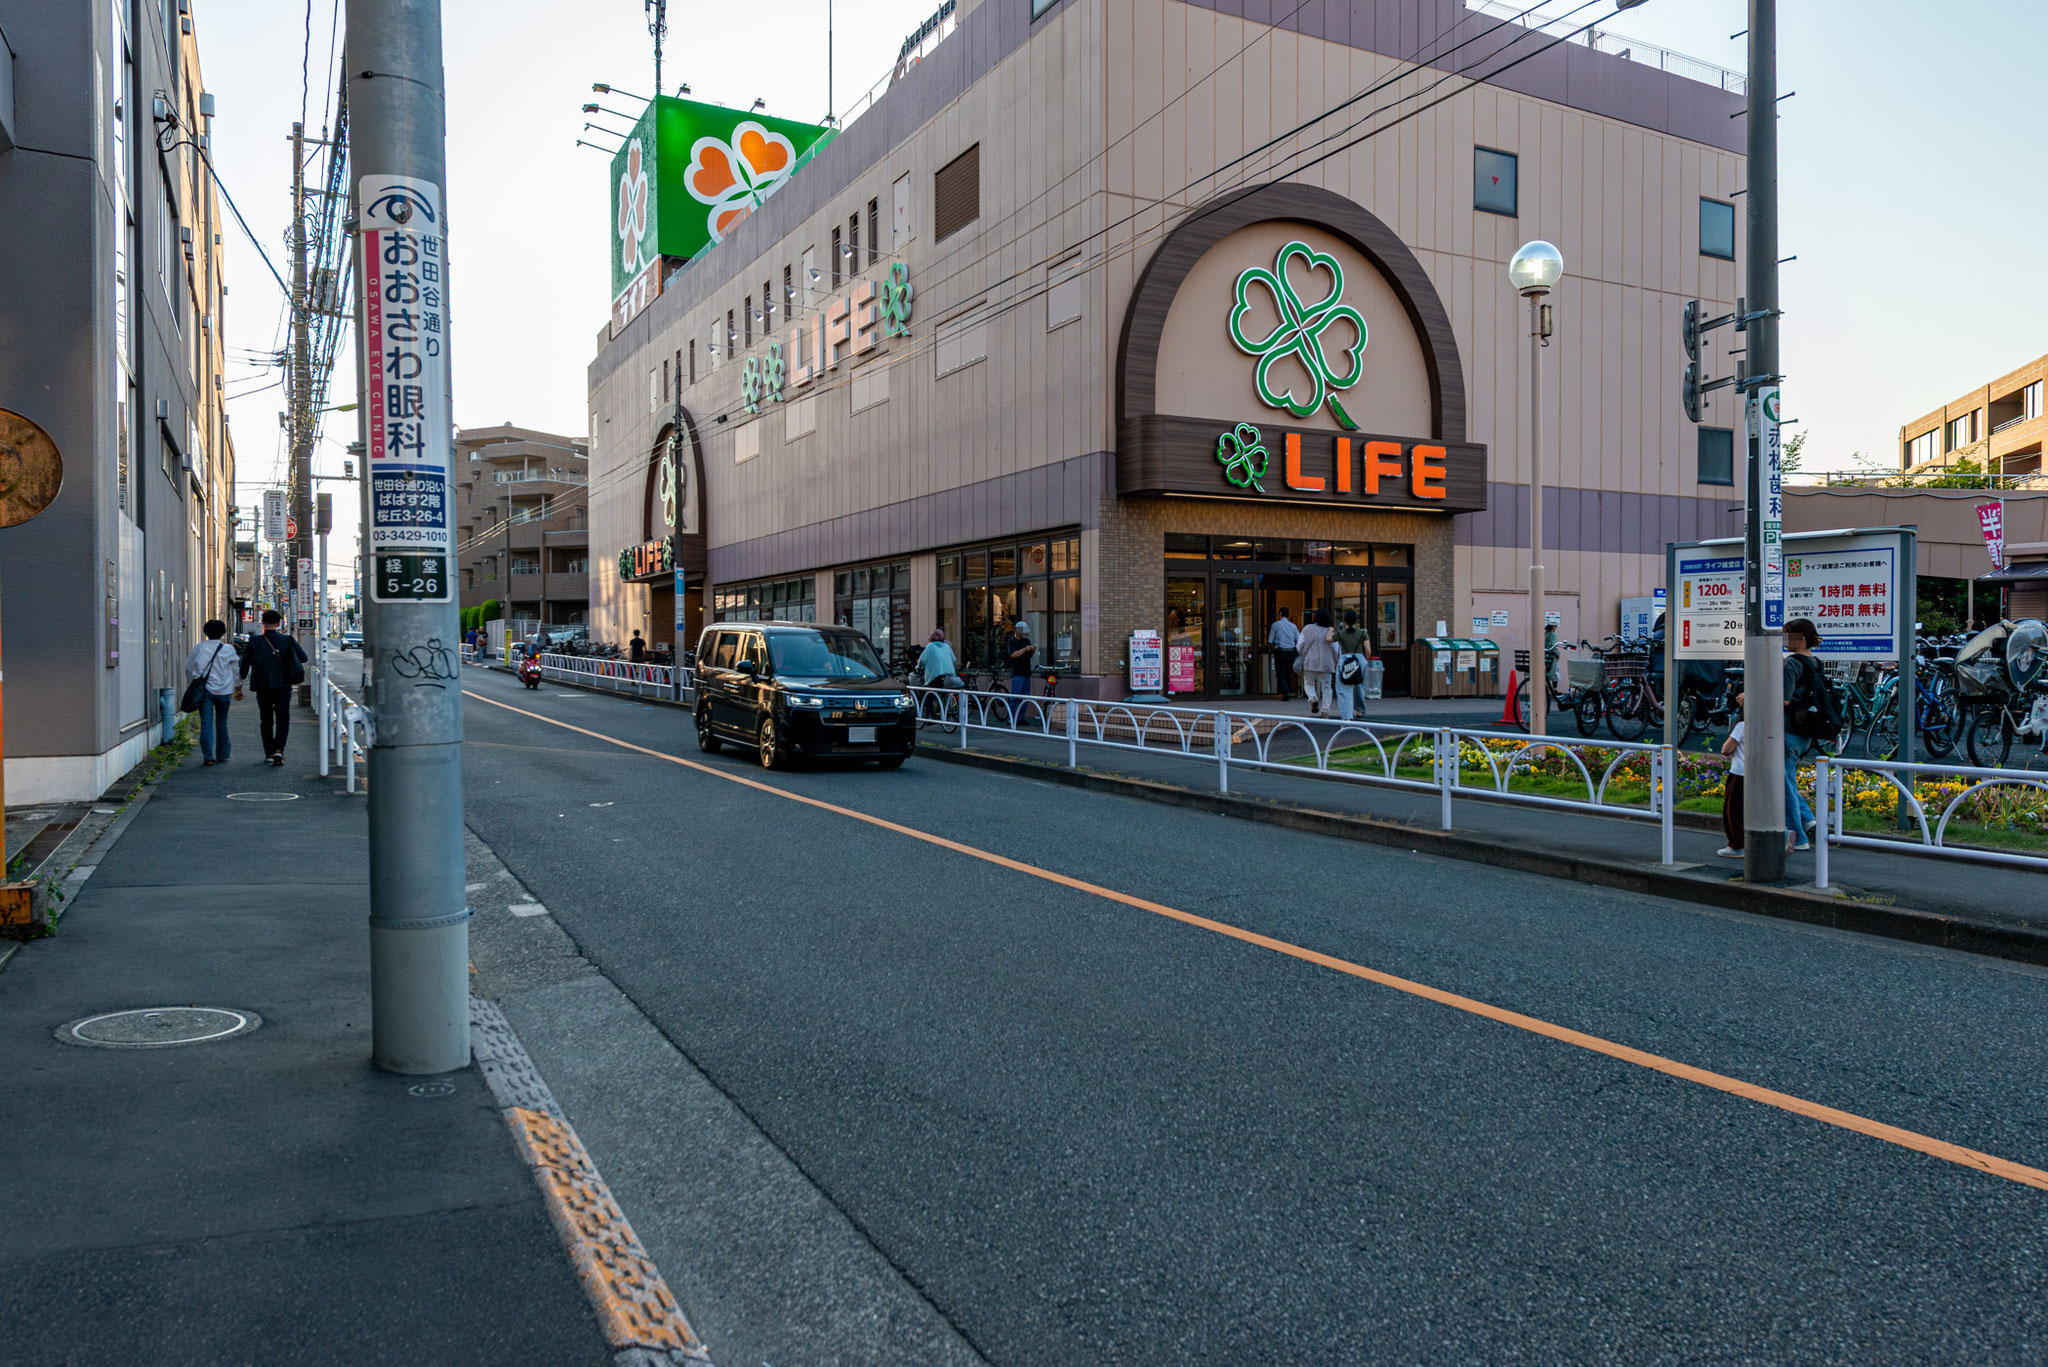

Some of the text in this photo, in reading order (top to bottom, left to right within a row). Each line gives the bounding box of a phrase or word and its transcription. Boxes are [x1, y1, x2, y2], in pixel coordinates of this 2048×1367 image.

[420, 234, 442, 358] 世田谷通り
[620, 274, 648, 326] ライフ
[790, 280, 877, 389] LIFE
[383, 230, 426, 459] おおさわ眼科
[369, 277, 383, 454] OSAWA EYE CLINIC
[1282, 432, 1447, 500] LIFE
[374, 478, 445, 493] 世田谷通り沿い
[376, 508, 444, 523] 桜丘3-26-4
[372, 530, 448, 542] 03-3429-1010
[1767, 532, 1775, 543] P
[385, 558, 438, 574] 経堂
[634, 540, 662, 577] LIFE
[387, 578, 438, 593] 5-26
[1697, 583, 1732, 597] 1200円
[1818, 583, 1887, 598] 1時間 無料
[1817, 602, 1887, 618] 2時間 無料
[1723, 620, 1743, 630] 20分
[1723, 636, 1743, 646] 60分
